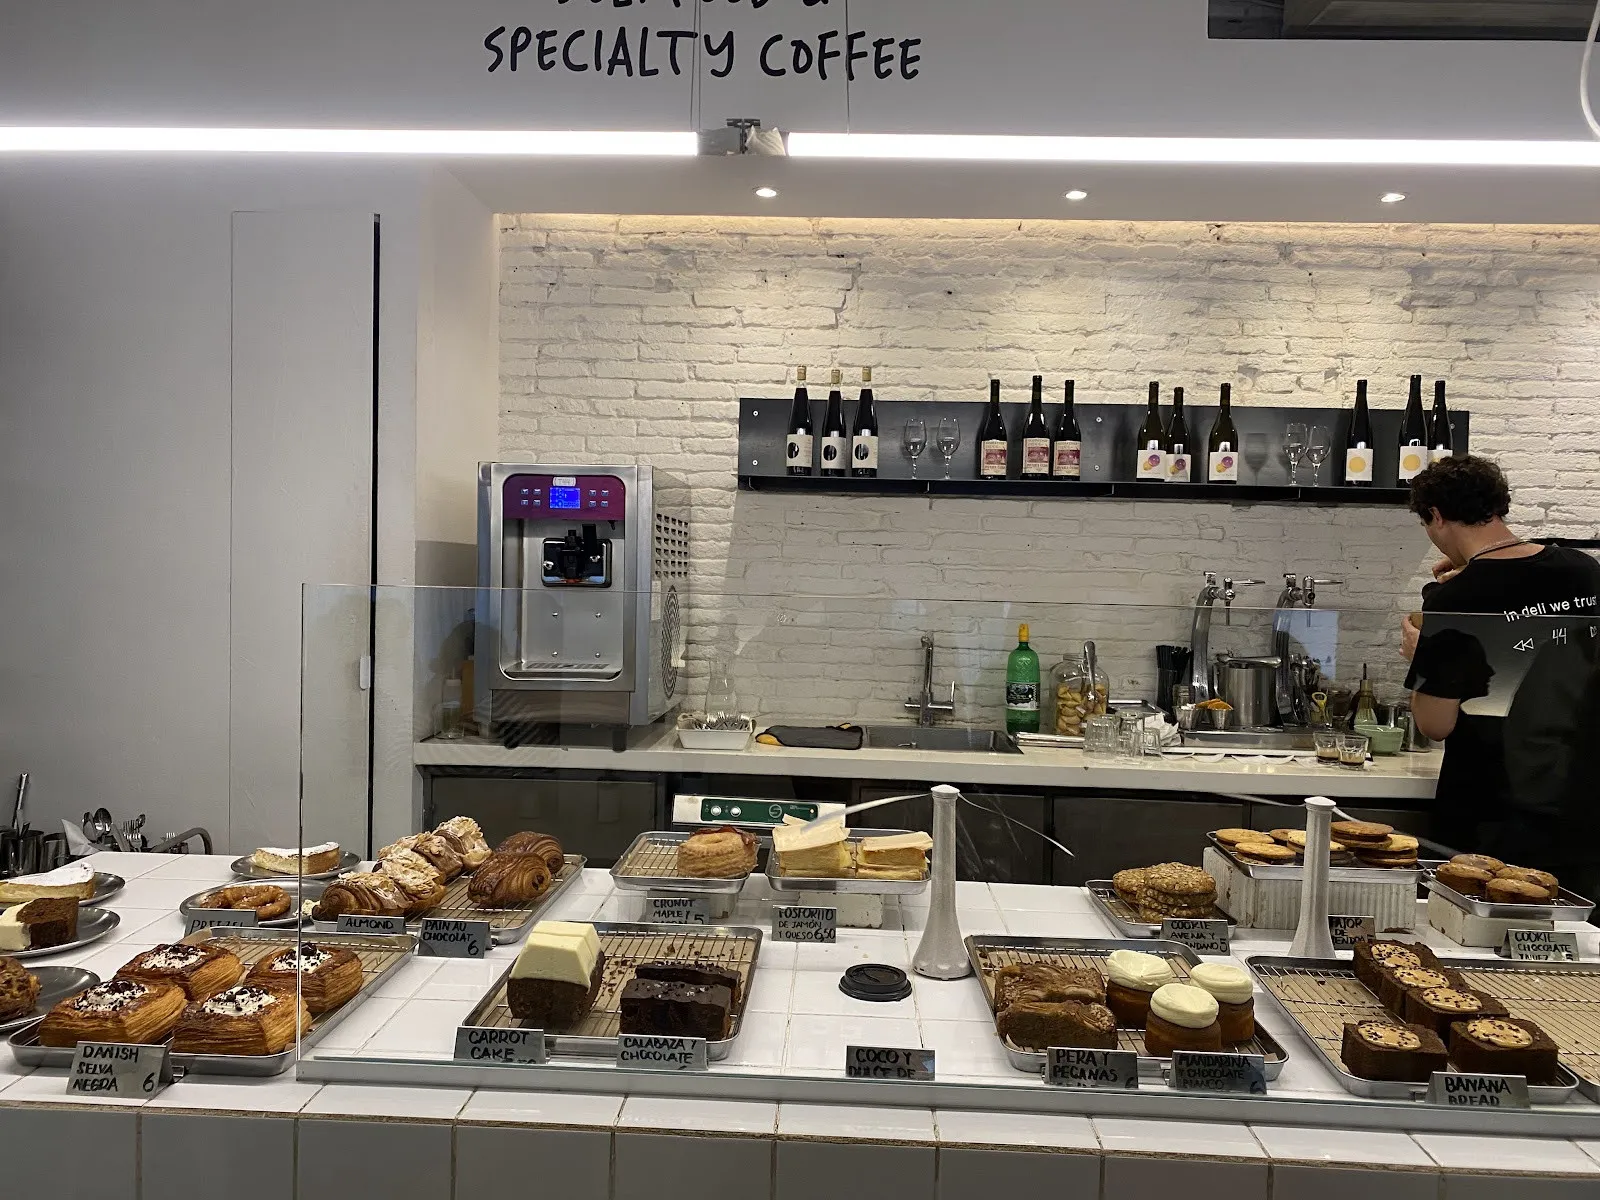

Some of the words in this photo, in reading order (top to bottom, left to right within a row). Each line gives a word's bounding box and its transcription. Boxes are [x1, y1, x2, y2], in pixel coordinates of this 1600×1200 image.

[484, 25, 734, 78] SPECIALTY
[759, 30, 923, 80] COFFEE
[1521, 602, 1547, 618] deli
[1549, 601, 1571, 613] we
[653, 899, 696, 908] CRONUT
[653, 910, 683, 918] MAPLE
[685, 911, 691, 920] Y
[345, 917, 395, 929] ALMOND
[424, 919, 451, 931] PAIN
[451, 920, 467, 932] AU
[791, 919, 822, 929] JAMÓN
[1170, 920, 1212, 930] COOKIE
[422, 931, 474, 942] CHOCOLAT
[778, 930, 783, 939] Y
[785, 930, 814, 940] QUESO
[1170, 931, 1206, 940] AVENA
[1208, 932, 1216, 940] Y
[1514, 931, 1557, 943] COOKIE
[467, 940, 480, 956] 6
[1219, 938, 1229, 953] 5
[1517, 943, 1572, 954] CHOCOLATE
[468, 1029, 530, 1045] CARROT
[623, 1037, 686, 1050] CALABAZA
[690, 1039, 698, 1050] Y
[82, 1045, 139, 1063] DANISH
[470, 1046, 515, 1060] CAKE
[620, 1049, 695, 1064] CHOCOLATE
[855, 1048, 900, 1064] COCO
[902, 1051, 912, 1066] Y
[1055, 1048, 1098, 1067] PERA
[1101, 1051, 1110, 1067] Y
[1178, 1053, 1251, 1067] MANDARINA
[76, 1061, 114, 1076] SELVA
[896, 1067, 916, 1079] DE
[1052, 1064, 1118, 1083] PECANAS
[1187, 1067, 1246, 1080] CHOCOLATE
[72, 1076, 119, 1092] NEGRA
[142, 1072, 155, 1093] 6
[1444, 1076, 1512, 1095] BANANA
[1448, 1094, 1501, 1107] BREAD
